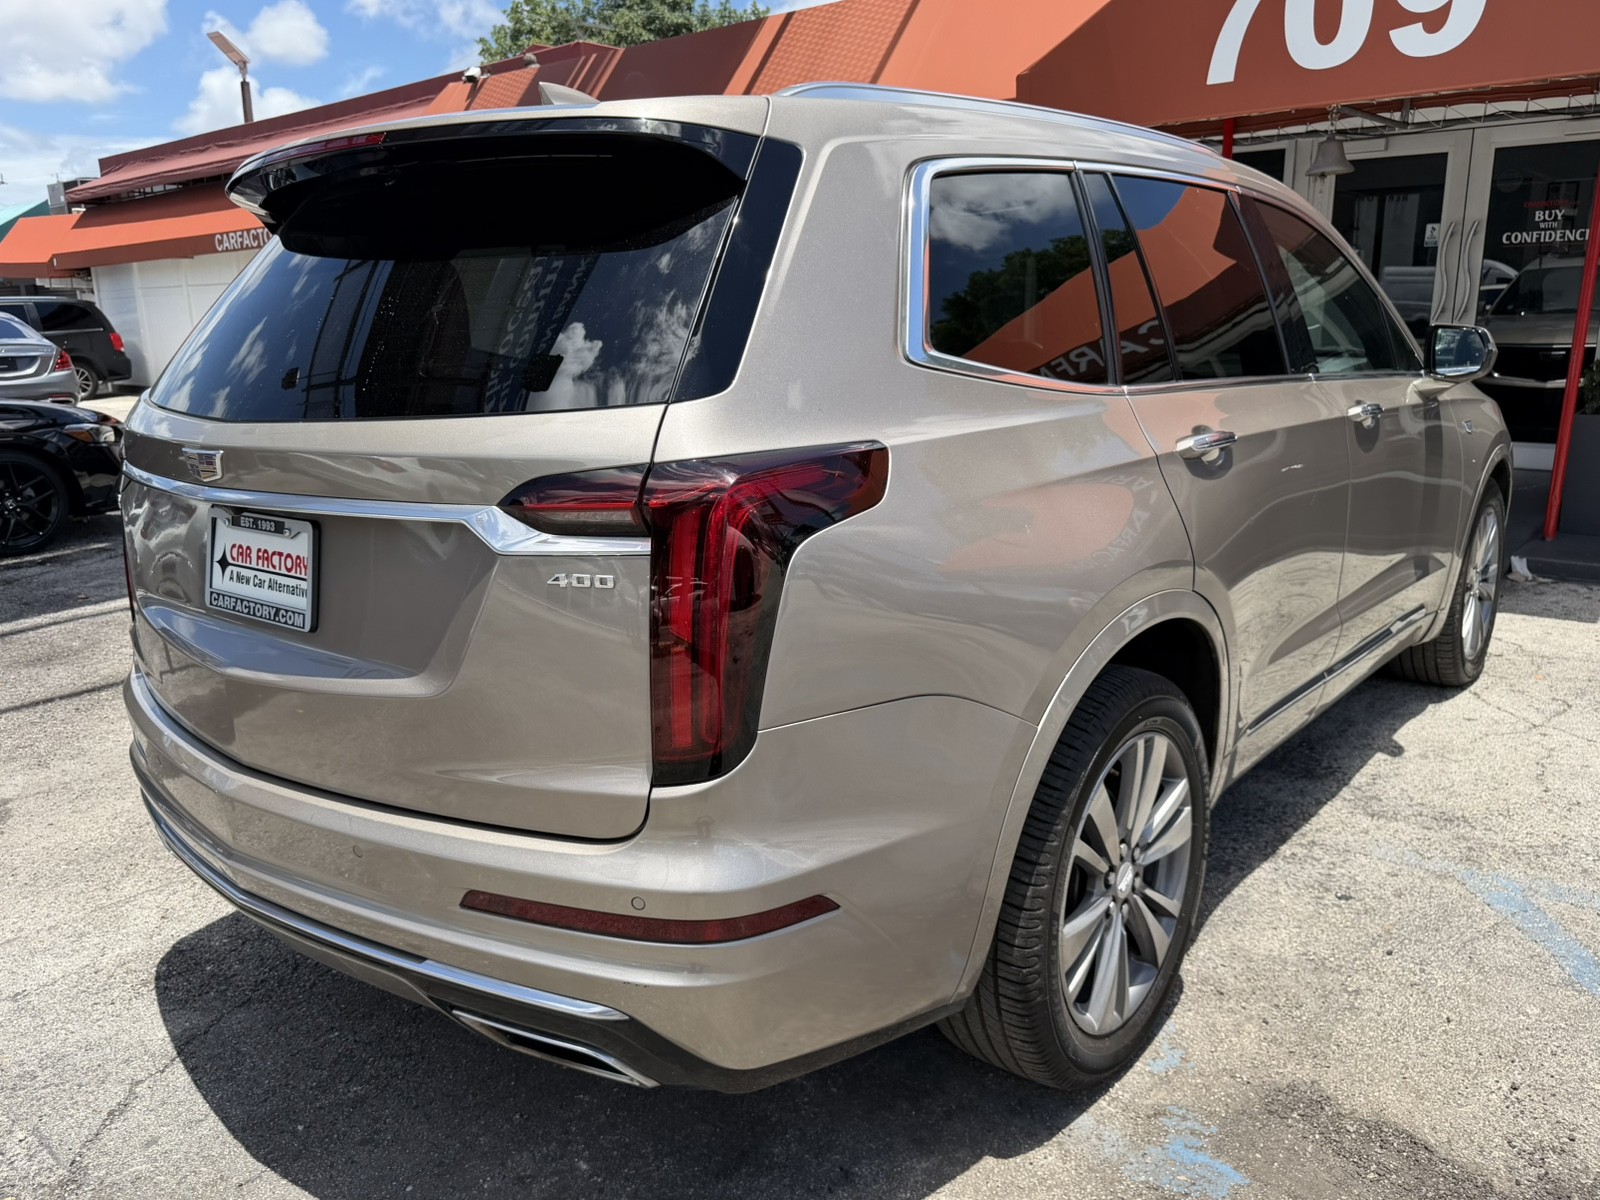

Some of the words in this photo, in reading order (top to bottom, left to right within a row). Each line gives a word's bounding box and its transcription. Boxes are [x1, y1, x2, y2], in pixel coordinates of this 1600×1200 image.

[1534, 209, 1565, 222] BUY
[1539, 221, 1558, 229] WITH
[240, 516, 256, 529] EST.
[257, 520, 276, 532] 1993
[229, 543, 253, 565] CAR
[256, 547, 308, 577] FACTORY
[229, 570, 235, 582] A
[236, 571, 251, 585] New
[252, 574, 266, 589] Car
[547, 573, 615, 589] 400
[211, 593, 304, 628] CARFACTORY.COM
